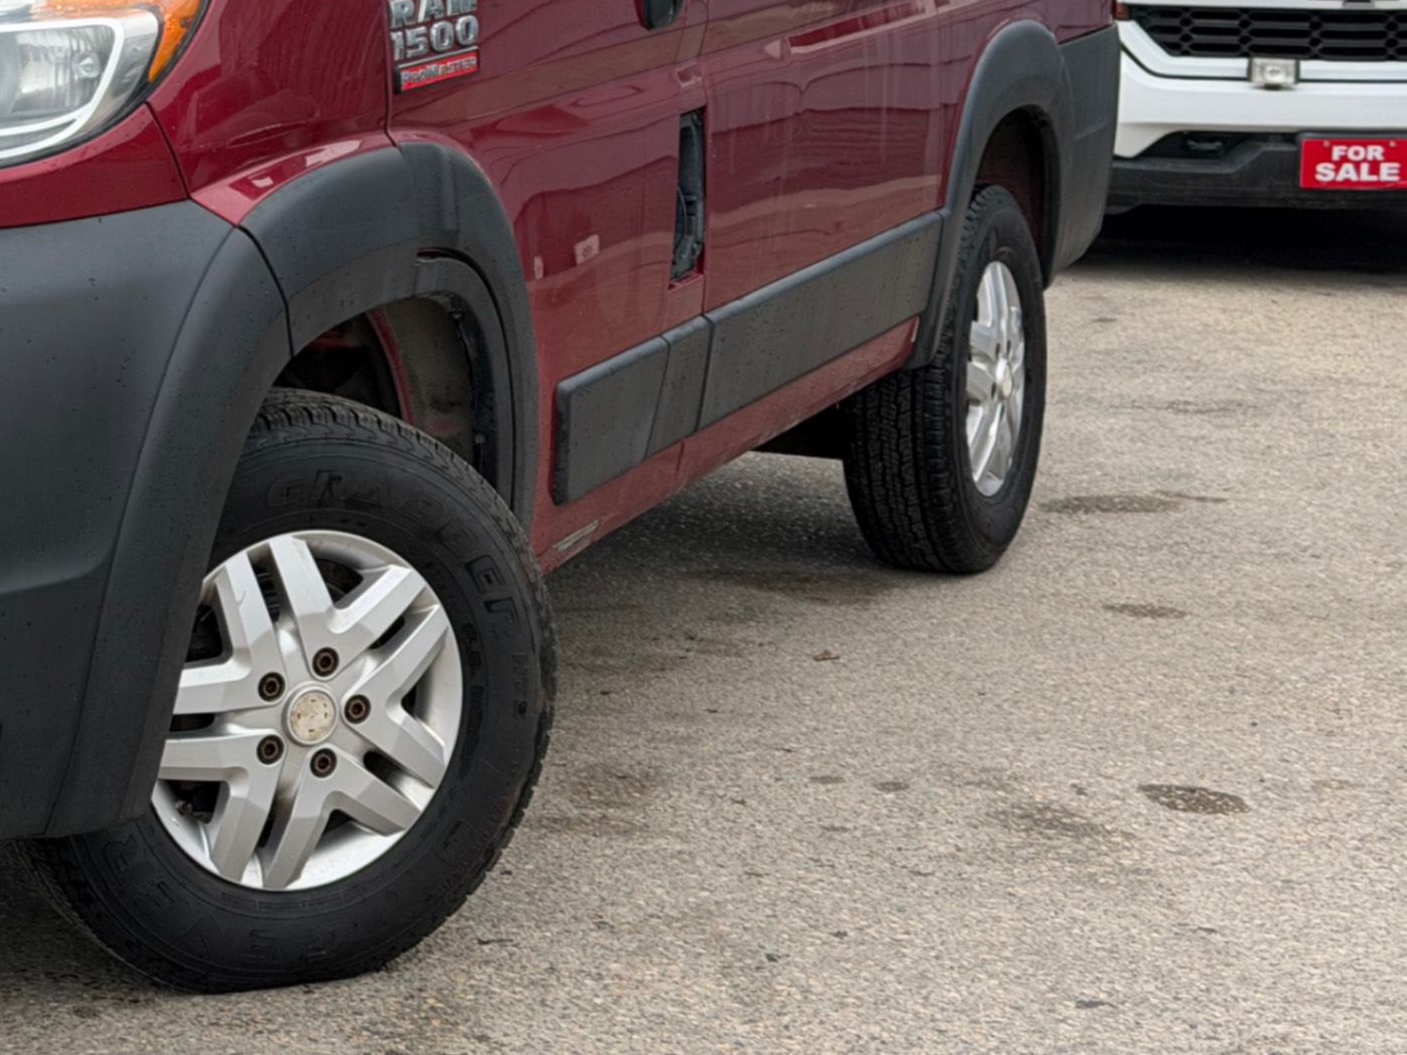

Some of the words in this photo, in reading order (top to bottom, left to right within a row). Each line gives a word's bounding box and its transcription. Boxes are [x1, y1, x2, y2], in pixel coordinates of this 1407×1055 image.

[391, 15, 479, 61] 1500
[1331, 145, 1385, 162] FOR
[1314, 162, 1401, 183] SALE
